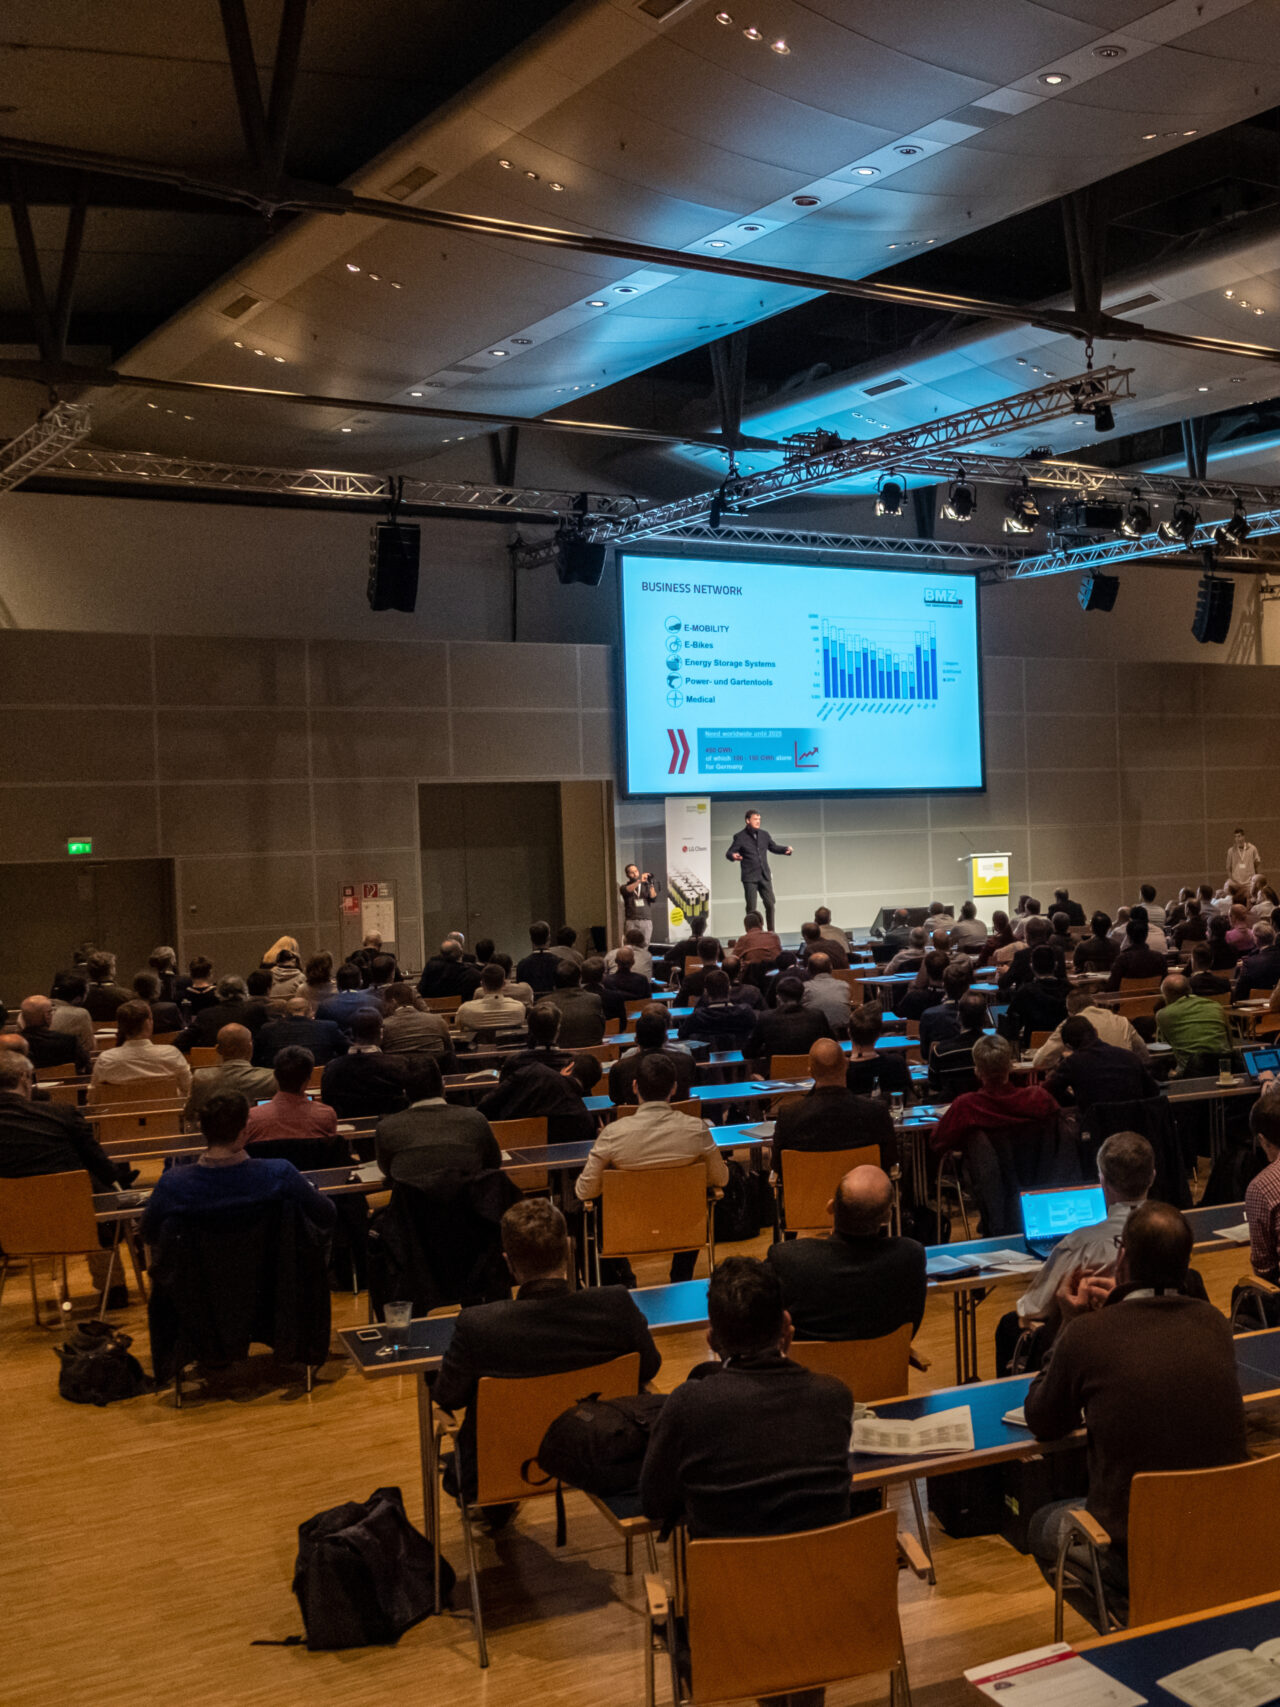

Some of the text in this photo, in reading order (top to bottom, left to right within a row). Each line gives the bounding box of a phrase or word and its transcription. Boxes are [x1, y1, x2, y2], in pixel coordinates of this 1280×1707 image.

[641, 581, 743, 596] BUSINESS NETWORK
[925, 589, 957, 602] BMZ
[684, 624, 730, 633] E-MOBILITY
[684, 641, 714, 649] E-Bikes
[684, 658, 776, 669] Energy Storage Systems
[685, 677, 712, 685] Power-
[730, 678, 774, 686] Gartentools
[686, 695, 716, 703] Medical
